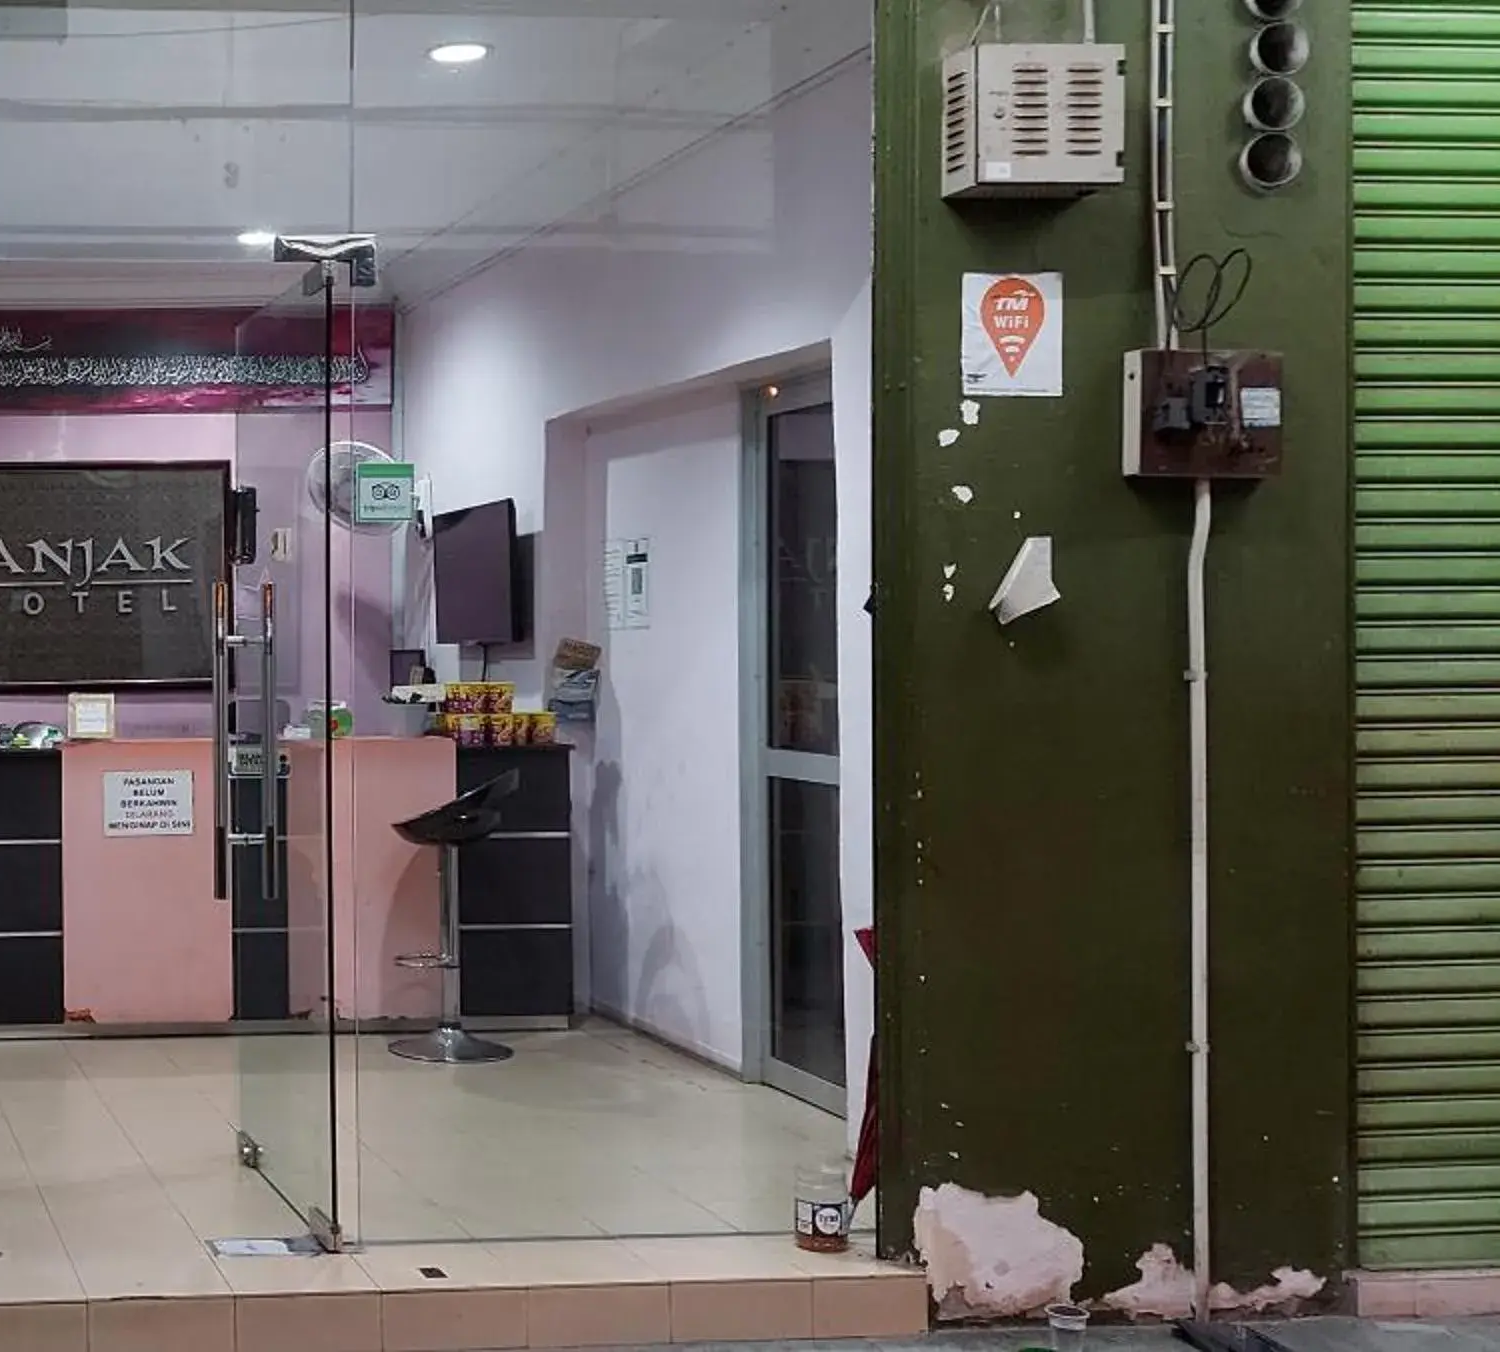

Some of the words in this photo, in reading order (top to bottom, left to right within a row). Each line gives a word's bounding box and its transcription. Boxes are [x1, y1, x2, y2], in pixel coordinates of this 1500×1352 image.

[993, 298, 1029, 311] TM
[993, 315, 1029, 328] WiFi
[133, 789, 165, 797] BELUM
